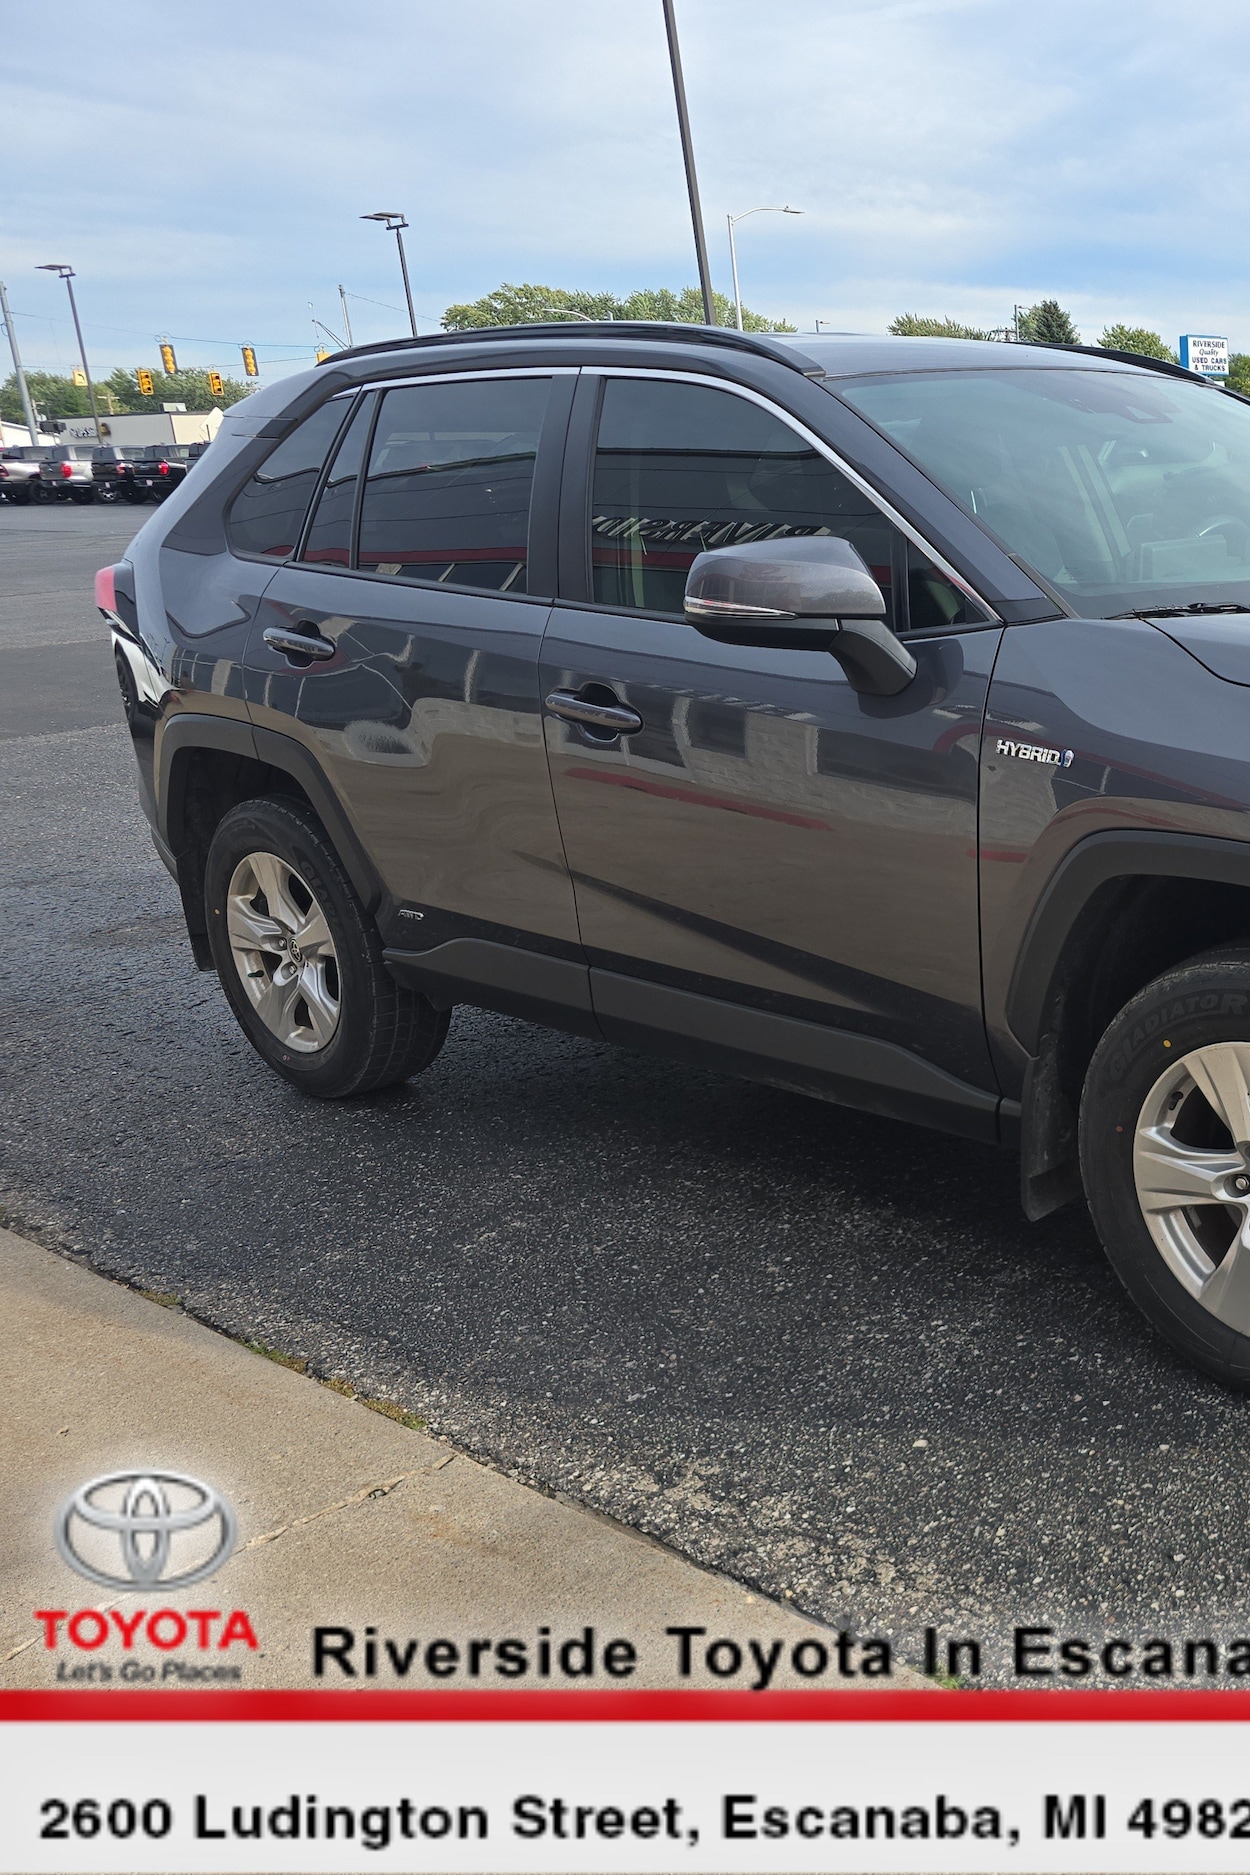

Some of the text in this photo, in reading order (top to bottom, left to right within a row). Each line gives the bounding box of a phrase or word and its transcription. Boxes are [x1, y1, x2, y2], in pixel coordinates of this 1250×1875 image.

[1192, 340, 1225, 348] RIVERSIDE
[996, 739, 1061, 766] HYBRID
[1108, 993, 1249, 1082] GLADIATOR
